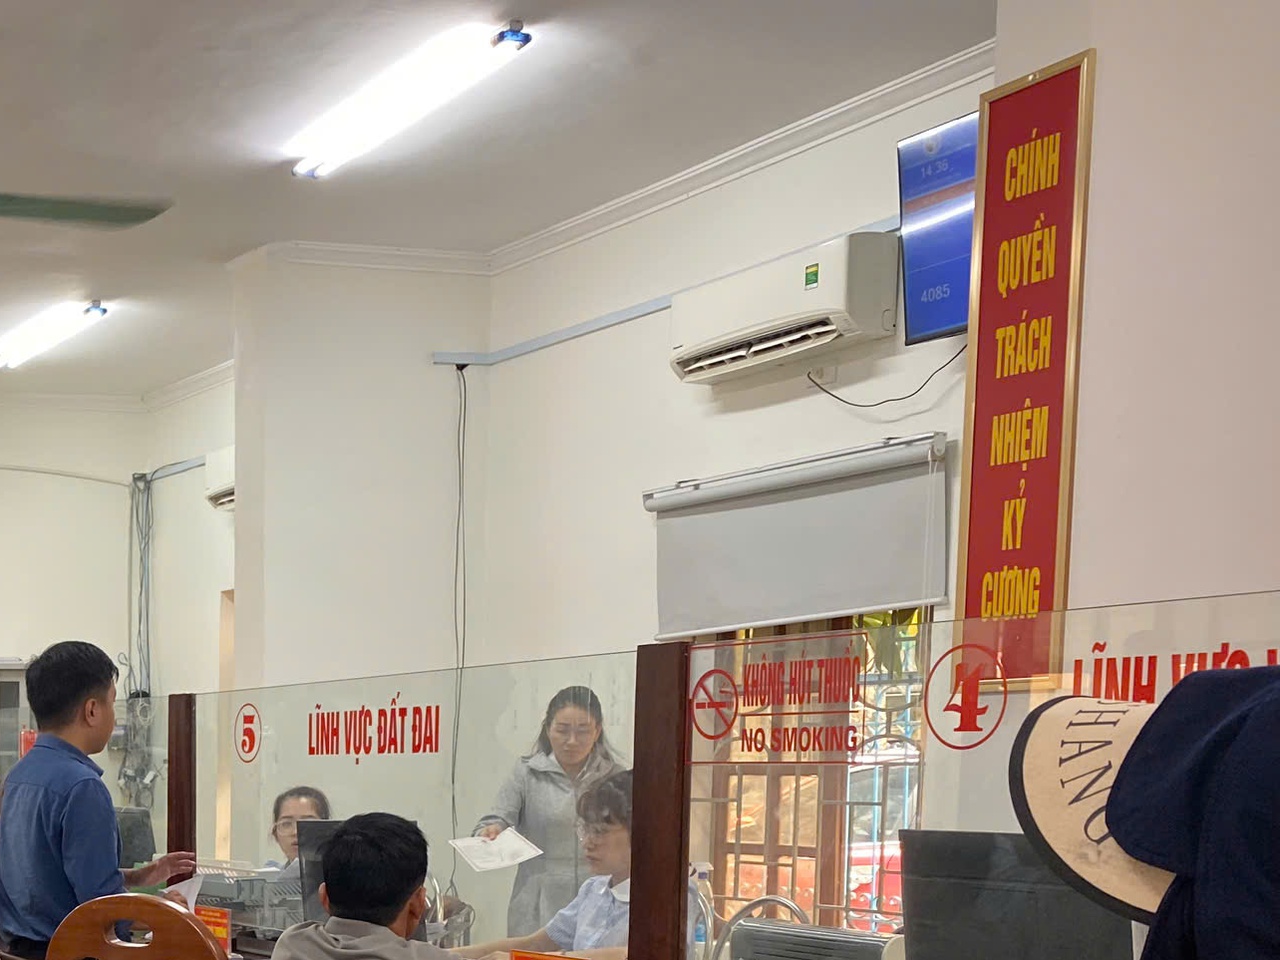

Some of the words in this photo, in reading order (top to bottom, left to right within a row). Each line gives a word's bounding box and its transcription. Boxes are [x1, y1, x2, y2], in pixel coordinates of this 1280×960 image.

[1004, 127, 1061, 201] CHÍNH
[997, 212, 1057, 299] QUYỀN
[920, 283, 951, 303] 4085
[995, 309, 1053, 379] TRÁCH
[989, 397, 1050, 472] NHIỆM
[1001, 478, 1027, 551] KỶ
[981, 565, 1041, 620] CƯƠNG
[743, 653, 786, 707] KHÔNG
[788, 649, 814, 706] HÚT
[817, 640, 861, 703] THUỐC
[942, 662, 991, 732] 4
[1072, 641, 1158, 704] LĨNH
[241, 713, 256, 754] 5
[308, 703, 340, 756] LĨNH
[344, 704, 373, 765] VỰC
[377, 691, 408, 754] ĐẤT
[412, 705, 440, 754] ĐAI
[741, 727, 766, 752] NO
[771, 725, 858, 752] SMOKING
